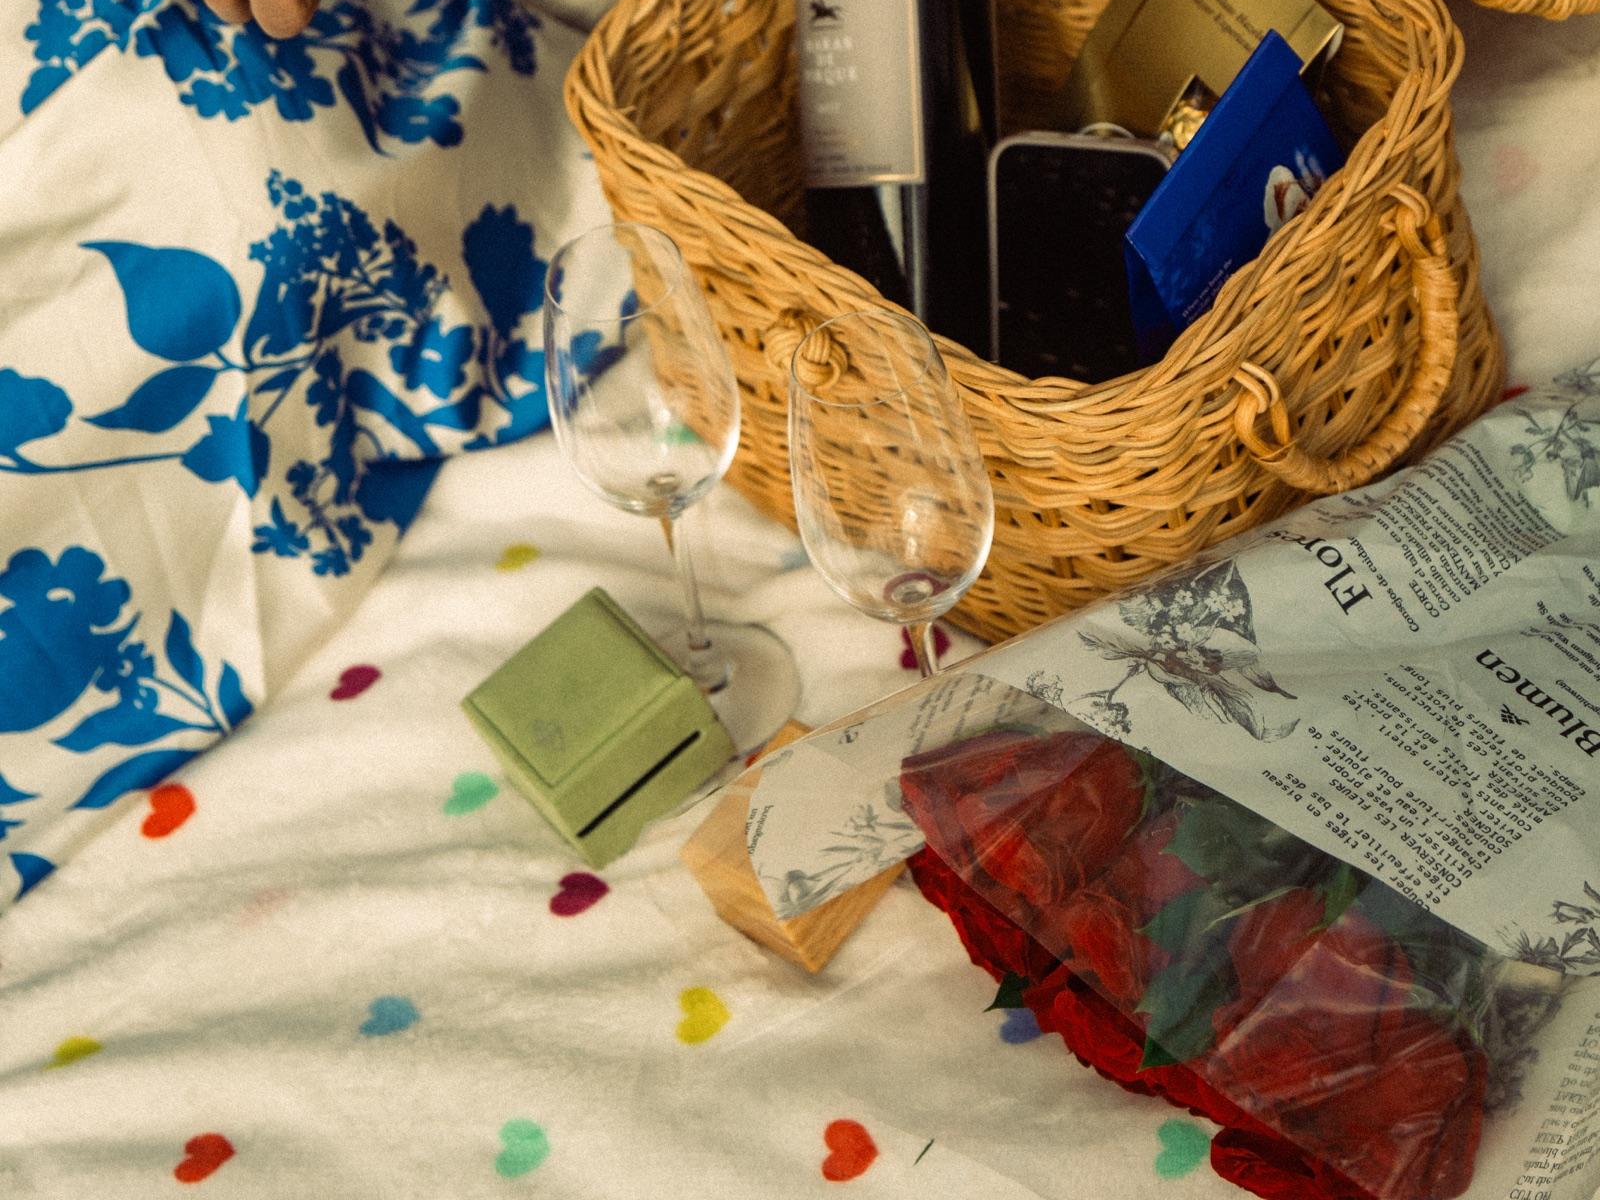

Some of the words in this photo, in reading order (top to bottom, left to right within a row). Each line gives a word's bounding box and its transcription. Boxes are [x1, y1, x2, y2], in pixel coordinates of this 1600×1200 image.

[1415, 485, 1438, 505] para
[1376, 517, 1390, 531] un
[1391, 500, 1428, 544] contacto
[1431, 514, 1461, 545] florero
[1435, 504, 1479, 552] nutrientes
[1389, 530, 1402, 543] en
[1404, 530, 1432, 564] afilado
[1428, 540, 1441, 553] en
[1466, 517, 1511, 571] CUIDADO
[1399, 542, 1418, 567] tallo
[1431, 530, 1481, 591] MANTENER
[1461, 544, 1474, 559] un
[1477, 547, 1496, 569] usar
[1375, 573, 1388, 587] de
[1414, 567, 1426, 578] el
[1428, 564, 1461, 603] cuchillo
[1438, 554, 1471, 596] entrarán
[1470, 560, 1490, 584] Usar
[1407, 578, 1440, 618] CORTE
[1422, 579, 1450, 611] Cortar
[1385, 587, 1420, 633] Consejos
[1341, 693, 1361, 711] les
[1413, 684, 1446, 711] votre
[1434, 688, 1463, 712] plus
[1475, 648, 1600, 756] Blumen
[1307, 725, 1323, 740] de
[1393, 722, 1408, 736] la
[1450, 714, 1465, 728] de
[1465, 712, 1505, 745] fleurs
[1329, 729, 1369, 762] fleurs
[1377, 724, 1418, 757] soleil
[1412, 737, 1428, 751] et
[1466, 740, 1487, 757] ces
[1324, 743, 1373, 780] ajouter
[1468, 728, 1537, 783] profiterez
[1510, 748, 1526, 761] de
[1284, 772, 1306, 790] des
[1321, 754, 1364, 789] propre
[1372, 765, 1403, 789] pour
[1421, 758, 1458, 787] plein
[1491, 759, 1539, 798] suivant
[1529, 763, 1578, 802] bouquet
[1260, 769, 1302, 802] biseau
[1328, 777, 1371, 811] FLEURS
[1375, 782, 1391, 796] et
[1485, 781, 1508, 799] des
[1487, 769, 1552, 817] APPRECIER
[1540, 785, 1568, 808] vous
[1305, 802, 1321, 817] en
[1309, 791, 1332, 811] bas
[1365, 790, 1393, 813] vase
[1475, 789, 1532, 832] courants
[1511, 800, 1543, 824] mité
[1544, 799, 1560, 812] En
[1334, 811, 1350, 826] le
[1373, 812, 1397, 832] LES
[1398, 814, 1414, 828] un
[1405, 790, 1473, 846] nourriture
[1462, 807, 1512, 848] SOIGNER
[1478, 808, 1522, 841] Eviter
[1324, 819, 1359, 849] tiges
[1353, 828, 1421, 886] effeuiller
[1362, 850, 1385, 871] les
[1399, 831, 1462, 888] CONSERVER
[1416, 832, 1473, 879] Utiliser
[1433, 829, 1485, 870] changer
[1475, 849, 1491, 864] la
[1414, 858, 1450, 896] tiges.
[1424, 889, 1441, 904] et
